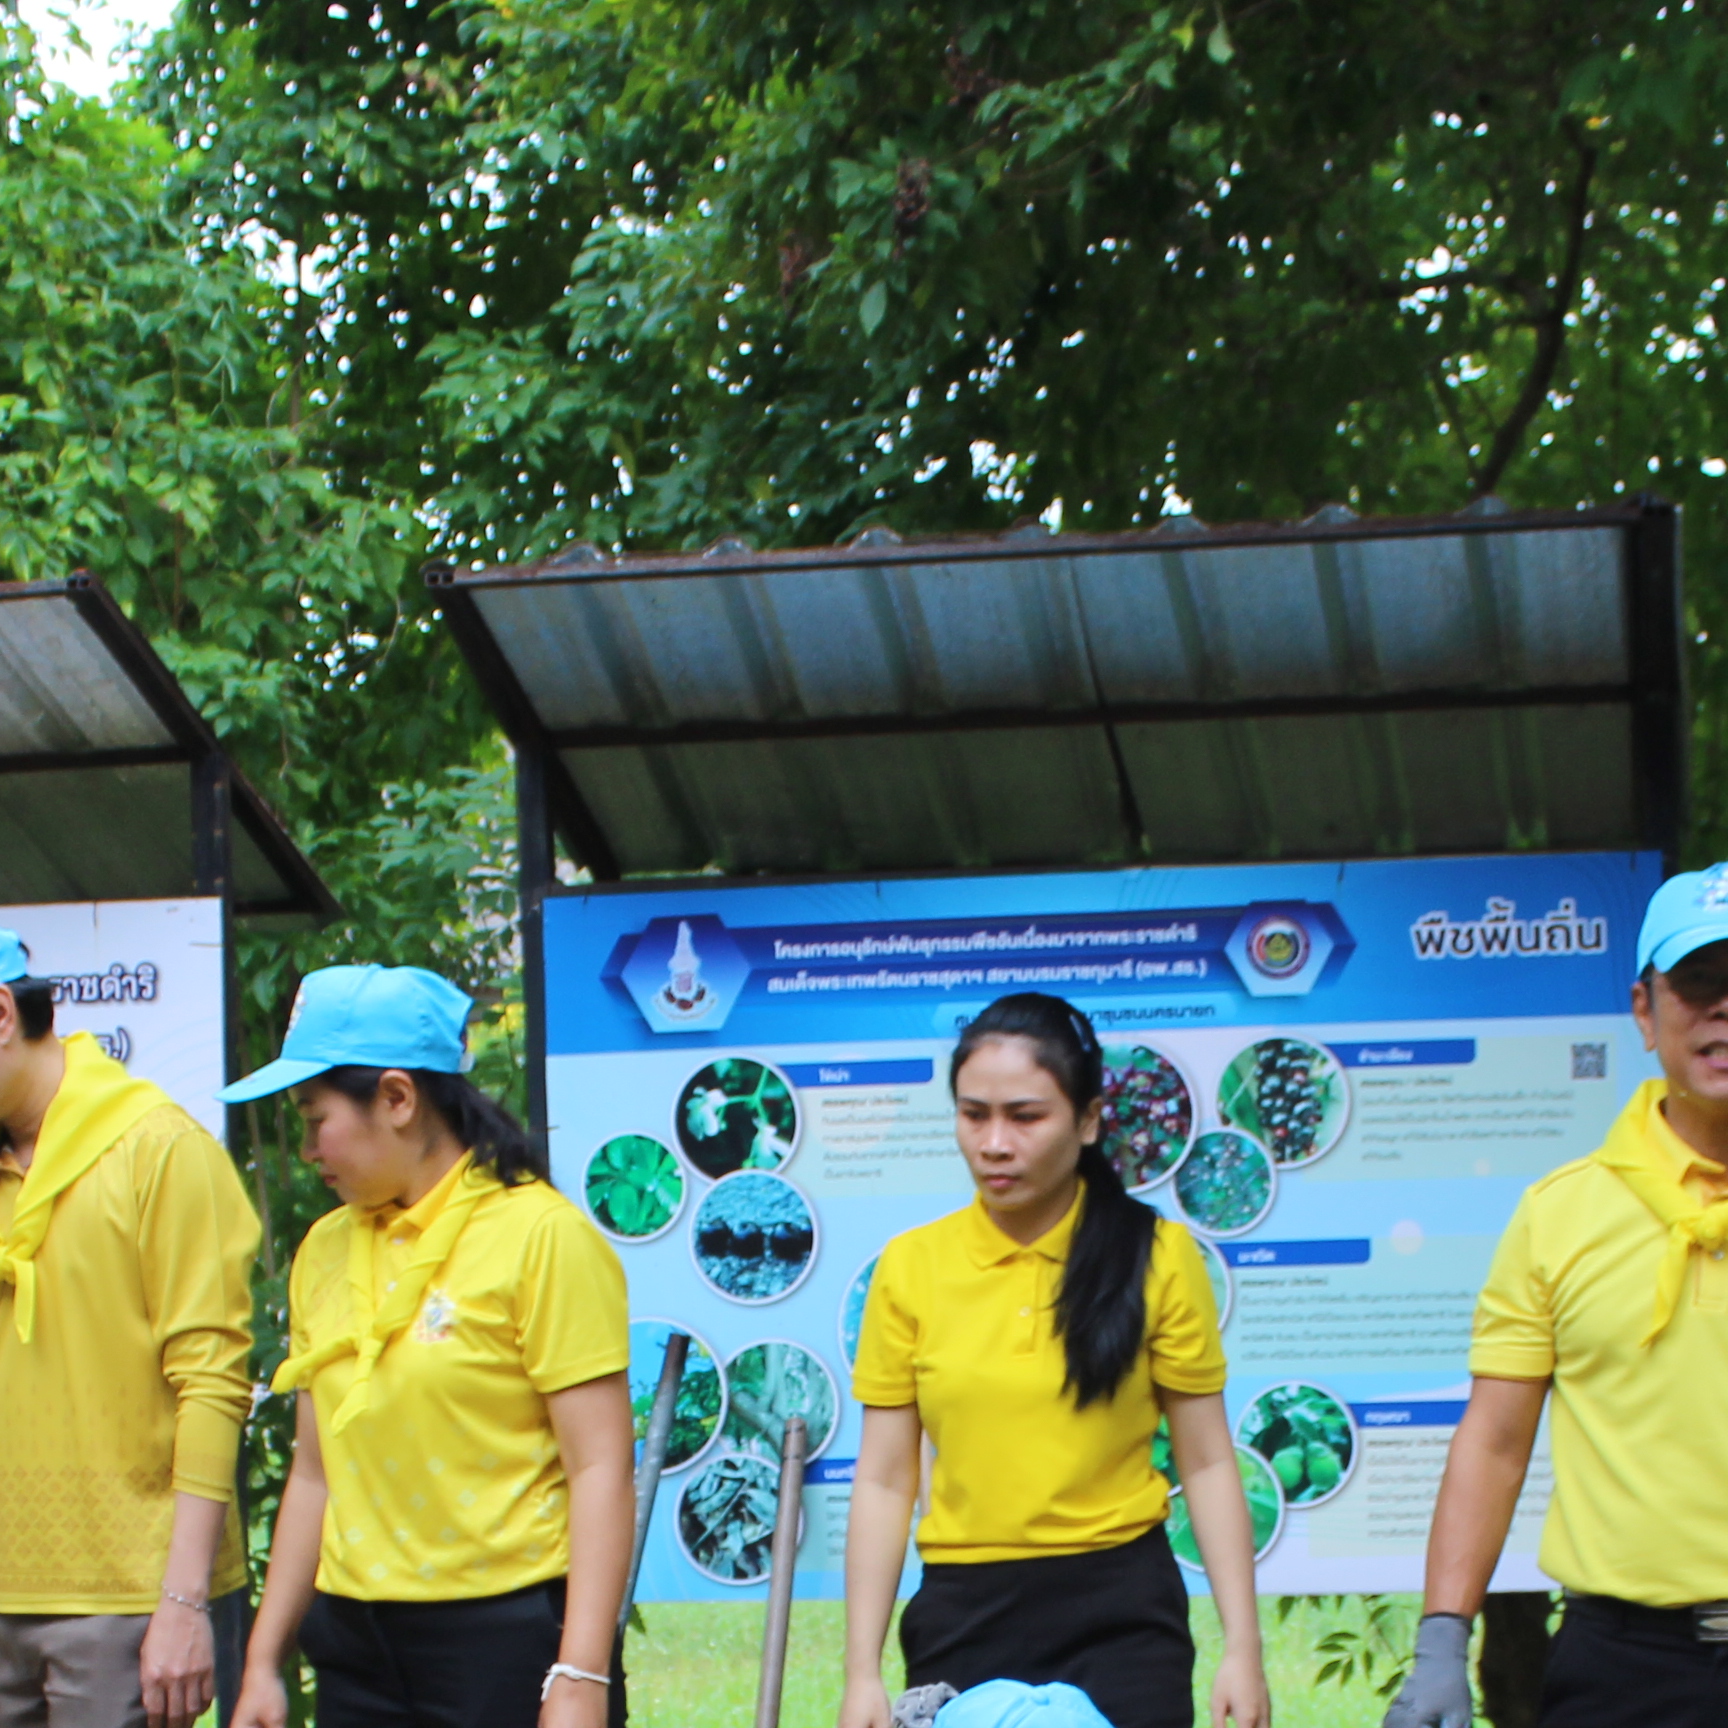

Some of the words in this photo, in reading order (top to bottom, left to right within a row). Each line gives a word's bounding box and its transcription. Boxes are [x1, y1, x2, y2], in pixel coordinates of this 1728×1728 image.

[1413, 900, 1603, 956] พืชพื้นถิ่น
